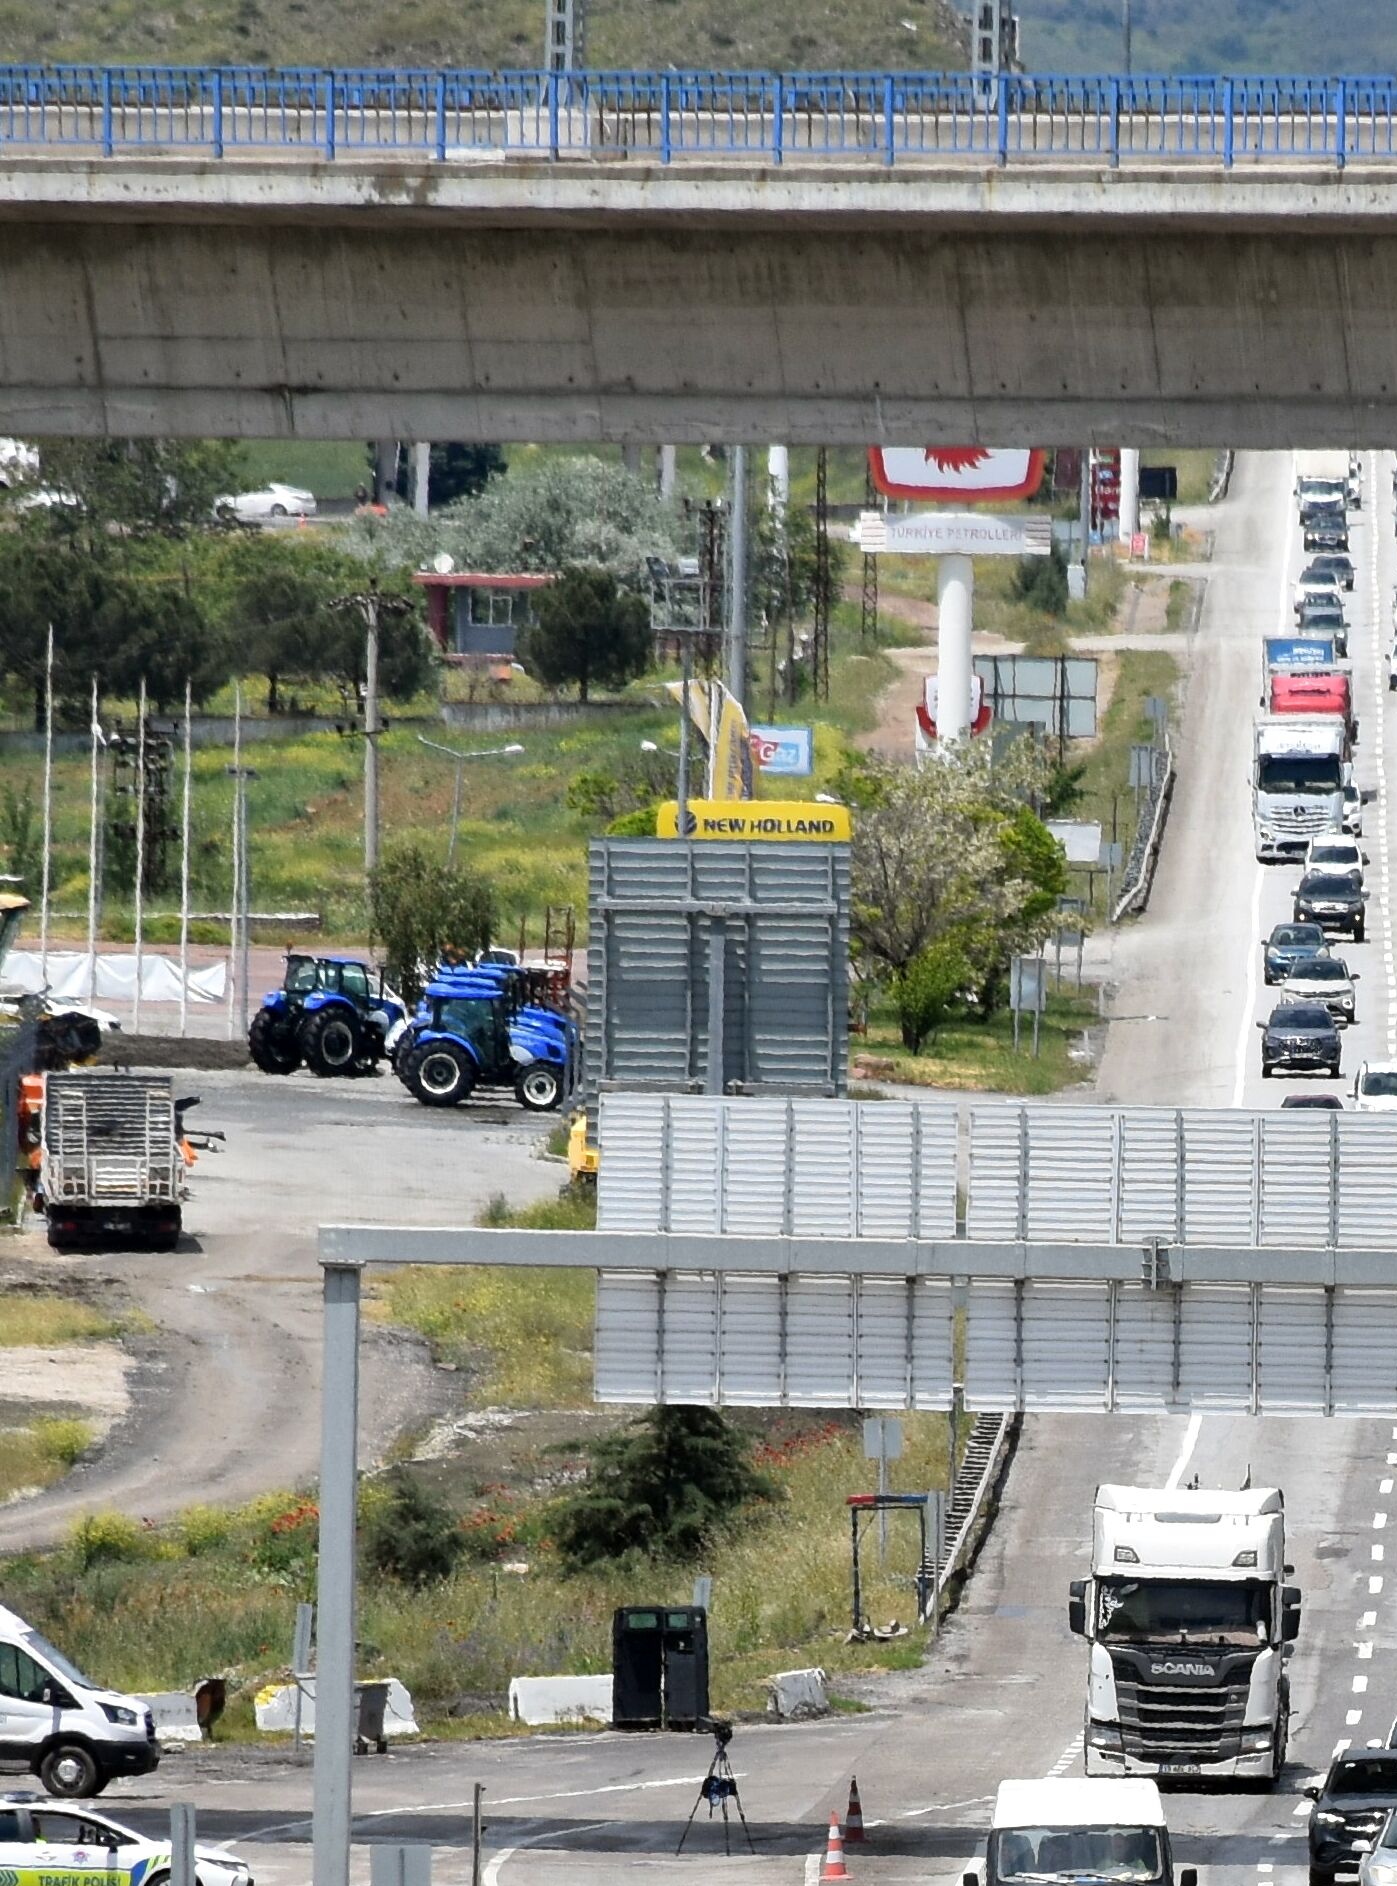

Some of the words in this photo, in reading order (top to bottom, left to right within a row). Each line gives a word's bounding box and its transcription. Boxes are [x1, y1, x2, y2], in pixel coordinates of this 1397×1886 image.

[703, 818, 745, 833] NEW
[750, 819, 835, 834] HOLLAND
[1151, 1662, 1215, 1677] SCANIA
